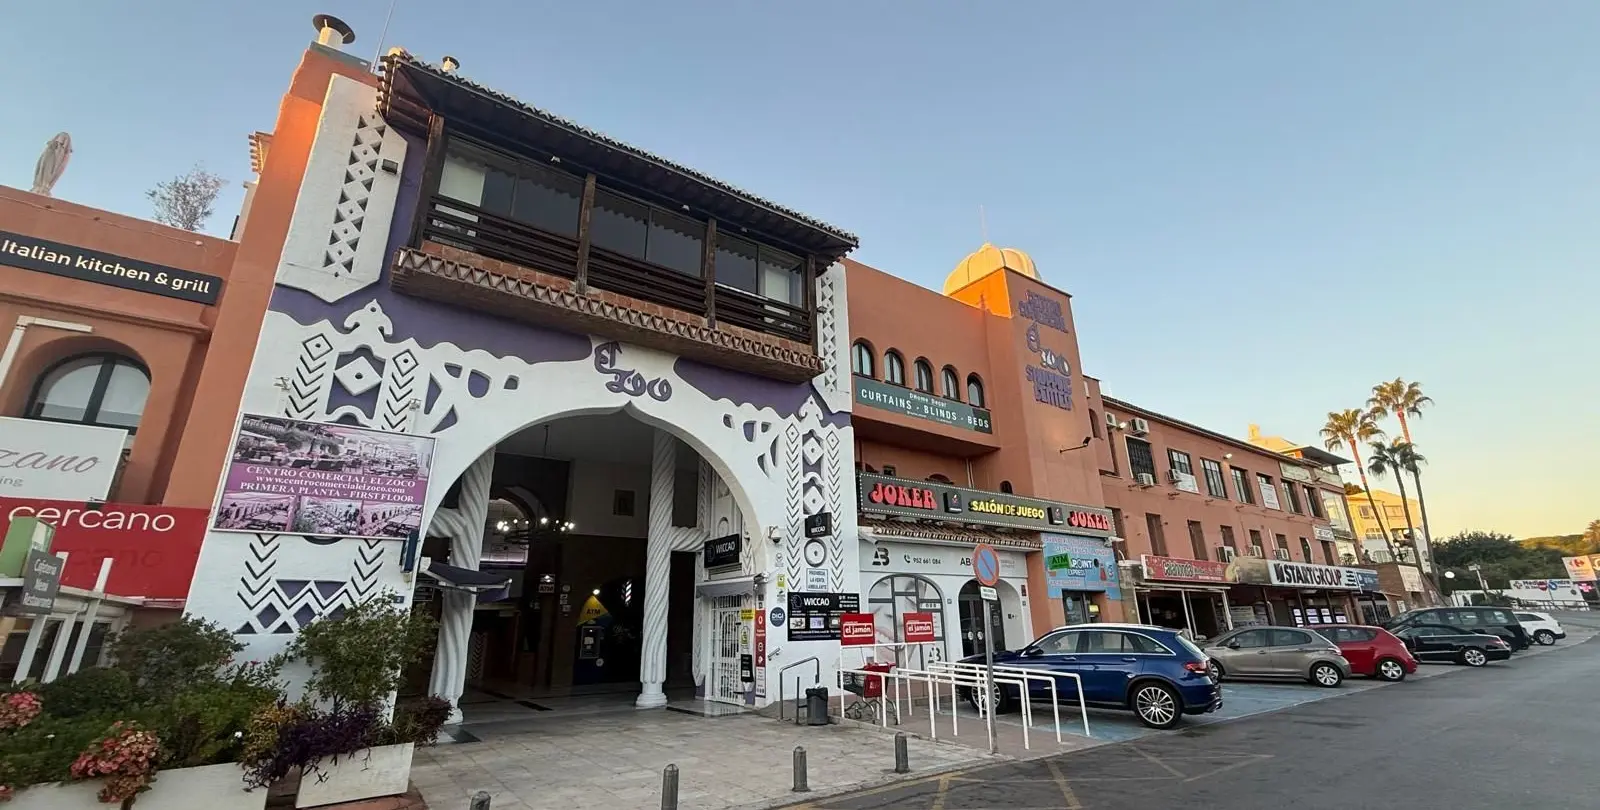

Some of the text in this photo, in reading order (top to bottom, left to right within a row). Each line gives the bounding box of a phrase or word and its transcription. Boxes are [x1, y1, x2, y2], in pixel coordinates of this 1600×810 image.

[1, 239, 210, 294] Italian kitchen & grill
[861, 388, 989, 428] CURTAINS BLINDS BEDS
[246, 465, 416, 488] CENTRO COMERCIAL EL ZOCO
[256, 475, 405, 494] www.centrocomercialelzoco.com
[240, 482, 295, 493] PRIMERA
[298, 485, 341, 497] PLANTA
[349, 490, 380, 500] FIRST
[381, 493, 414, 503] FLOOR
[870, 482, 1111, 531] JOKER SALÓN DE JUEGO JOKER
[811, 526, 826, 534] WICCAO
[715, 541, 736, 555] WICCAO
[1051, 553, 1068, 565] ATM
[1071, 558, 1093, 569] POINT
[1283, 564, 1342, 586] STARTGROUP
[803, 597, 830, 606] WICCAO
[845, 626, 851, 634] el
[851, 625, 871, 635] jamón
[913, 623, 931, 633] jamón
